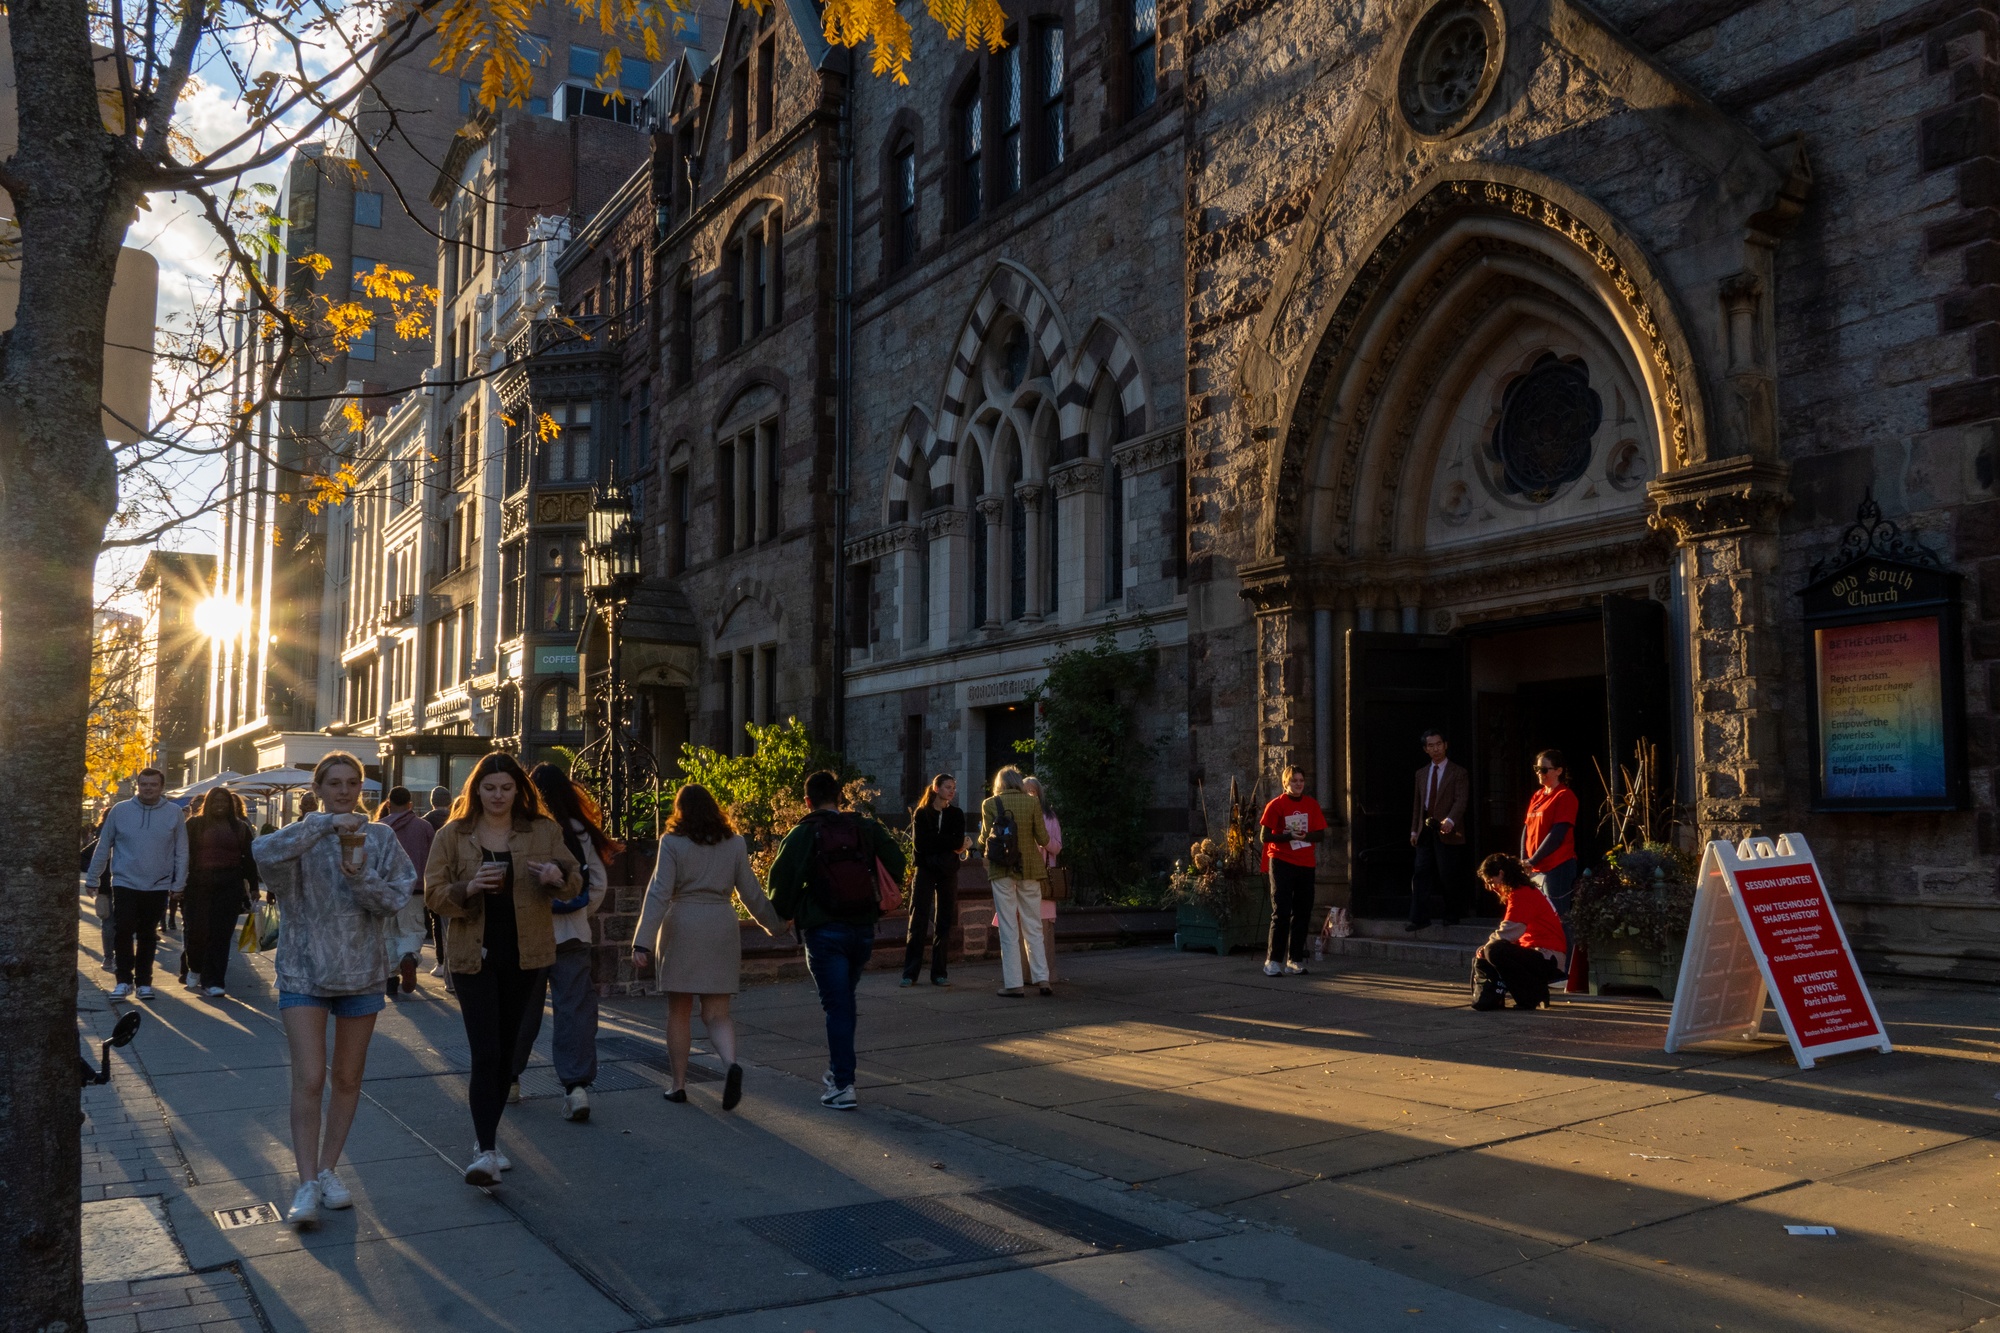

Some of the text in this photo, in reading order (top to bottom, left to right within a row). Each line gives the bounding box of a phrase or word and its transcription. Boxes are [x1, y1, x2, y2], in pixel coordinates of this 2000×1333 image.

[1832, 566, 1913, 597] Old South
[1847, 585, 1899, 606] Church
[1829, 640, 1841, 649] BE
[1843, 637, 1863, 647] THE
[542, 655, 577, 664] COFFEE
[1830, 671, 1890, 685] Reject racism.
[1830, 681, 1915, 696] Fight climate change.
[1831, 717, 1889, 730] Empower the
[1855, 741, 1885, 752] earthly
[1885, 739, 1901, 749] and
[1832, 763, 1897, 776] Enjoy this life.
[1745, 875, 1813, 891] SESSION UPDATES!
[1753, 897, 1820, 913] HOW TECHNOLOGY
[1762, 909, 1820, 924] SHAPES HISTORY
[1772, 929, 1784, 937] with
[1781, 936, 1790, 944] and
[1784, 953, 1798, 961] South
[1799, 951, 1816, 959] Church
[1816, 948, 1839, 957] Sanctuary
[1793, 969, 1838, 984] ART HISTORY
[1802, 982, 1838, 995] KEYNOTE:
[1803, 993, 1847, 1007] Paris in Ruins
[1804, 1029, 1820, 1037] Boston
[1820, 1027, 1834, 1035] Public
[1834, 1024, 1849, 1033] Library
